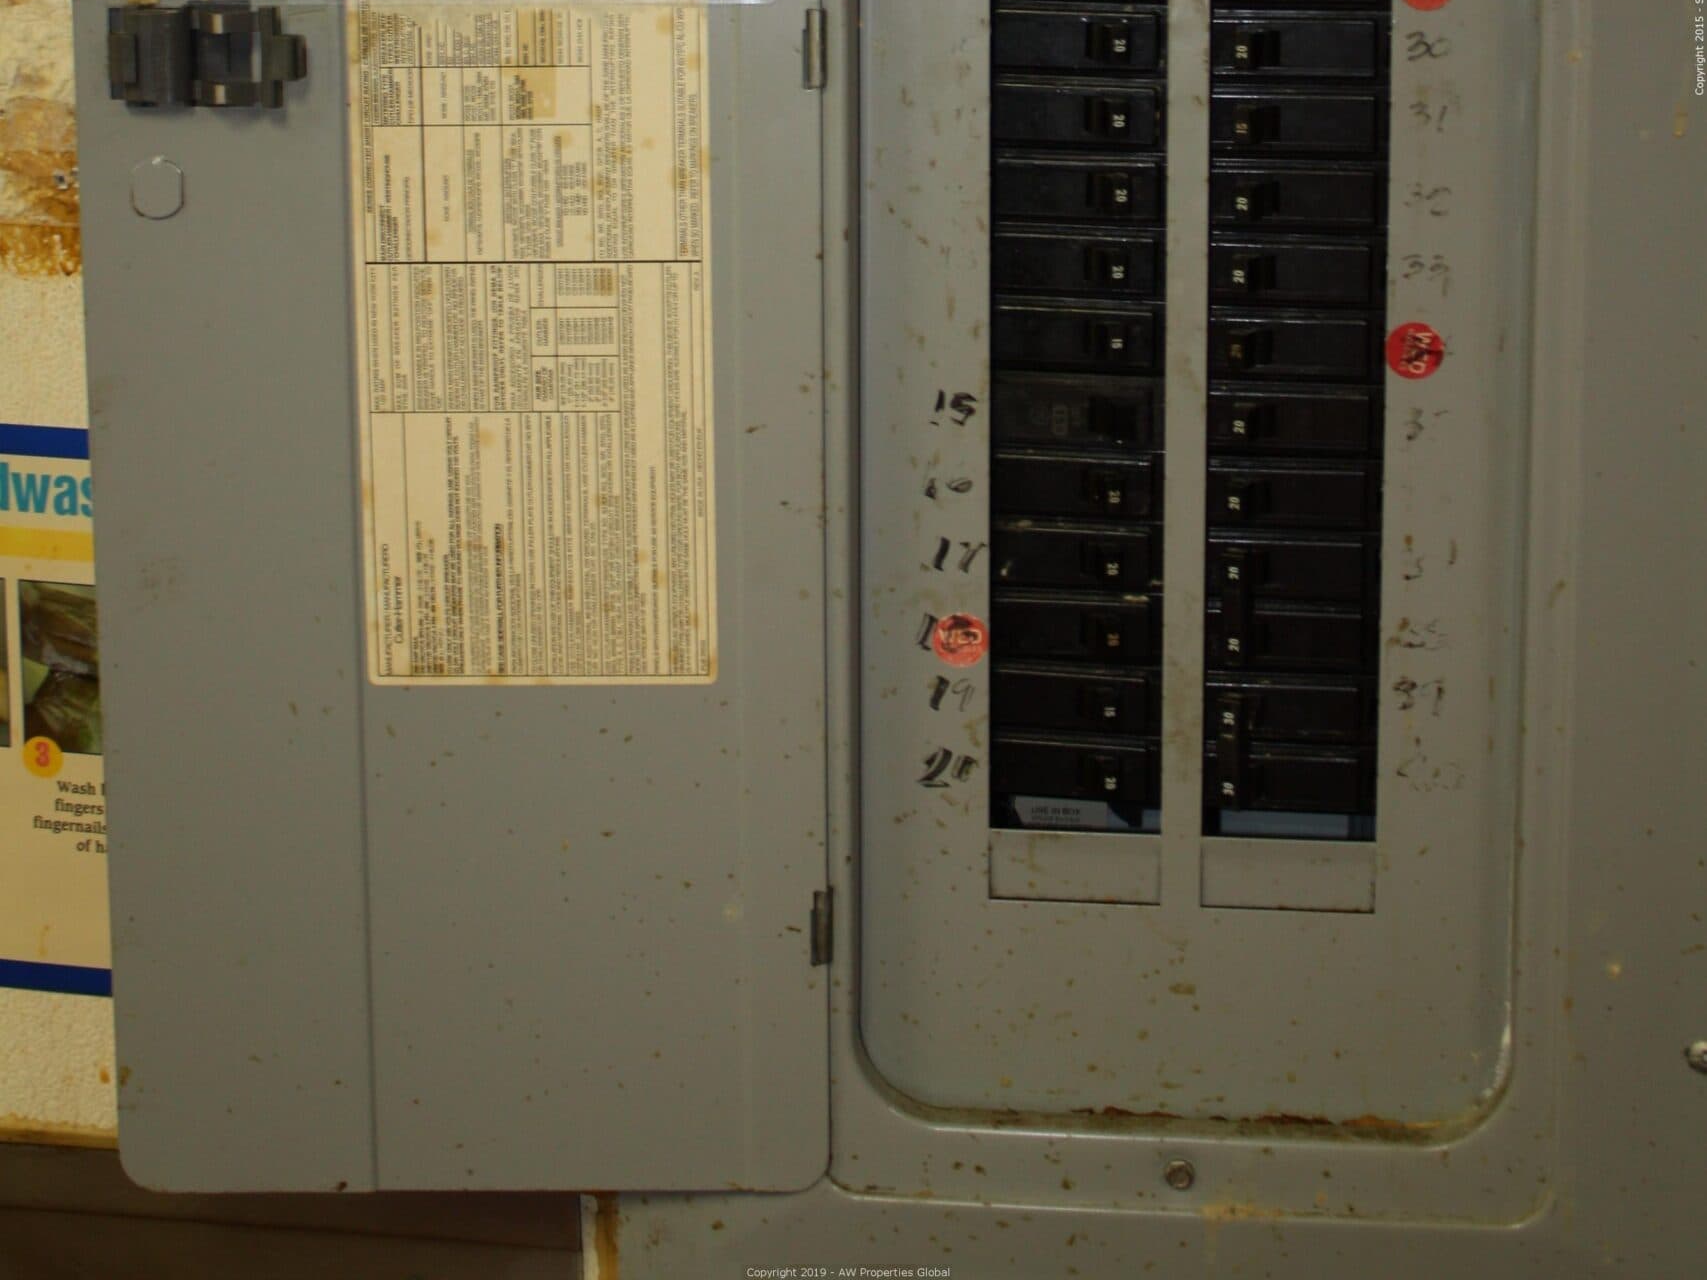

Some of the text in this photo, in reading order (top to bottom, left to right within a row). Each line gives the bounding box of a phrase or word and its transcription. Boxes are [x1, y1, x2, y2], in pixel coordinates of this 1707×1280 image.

[1405, 31, 1450, 61] 30
[1409, 101, 1449, 132] 31
[933, 390, 978, 426] 15
[934, 536, 988, 573] 17
[393, 575, 405, 645] Cutler-Hammer
[929, 675, 976, 712] 19
[34, 741, 50, 767] 3
[57, 780, 97, 796] Wash
[55, 798, 104, 817] fingers
[76, 839, 92, 853] of
